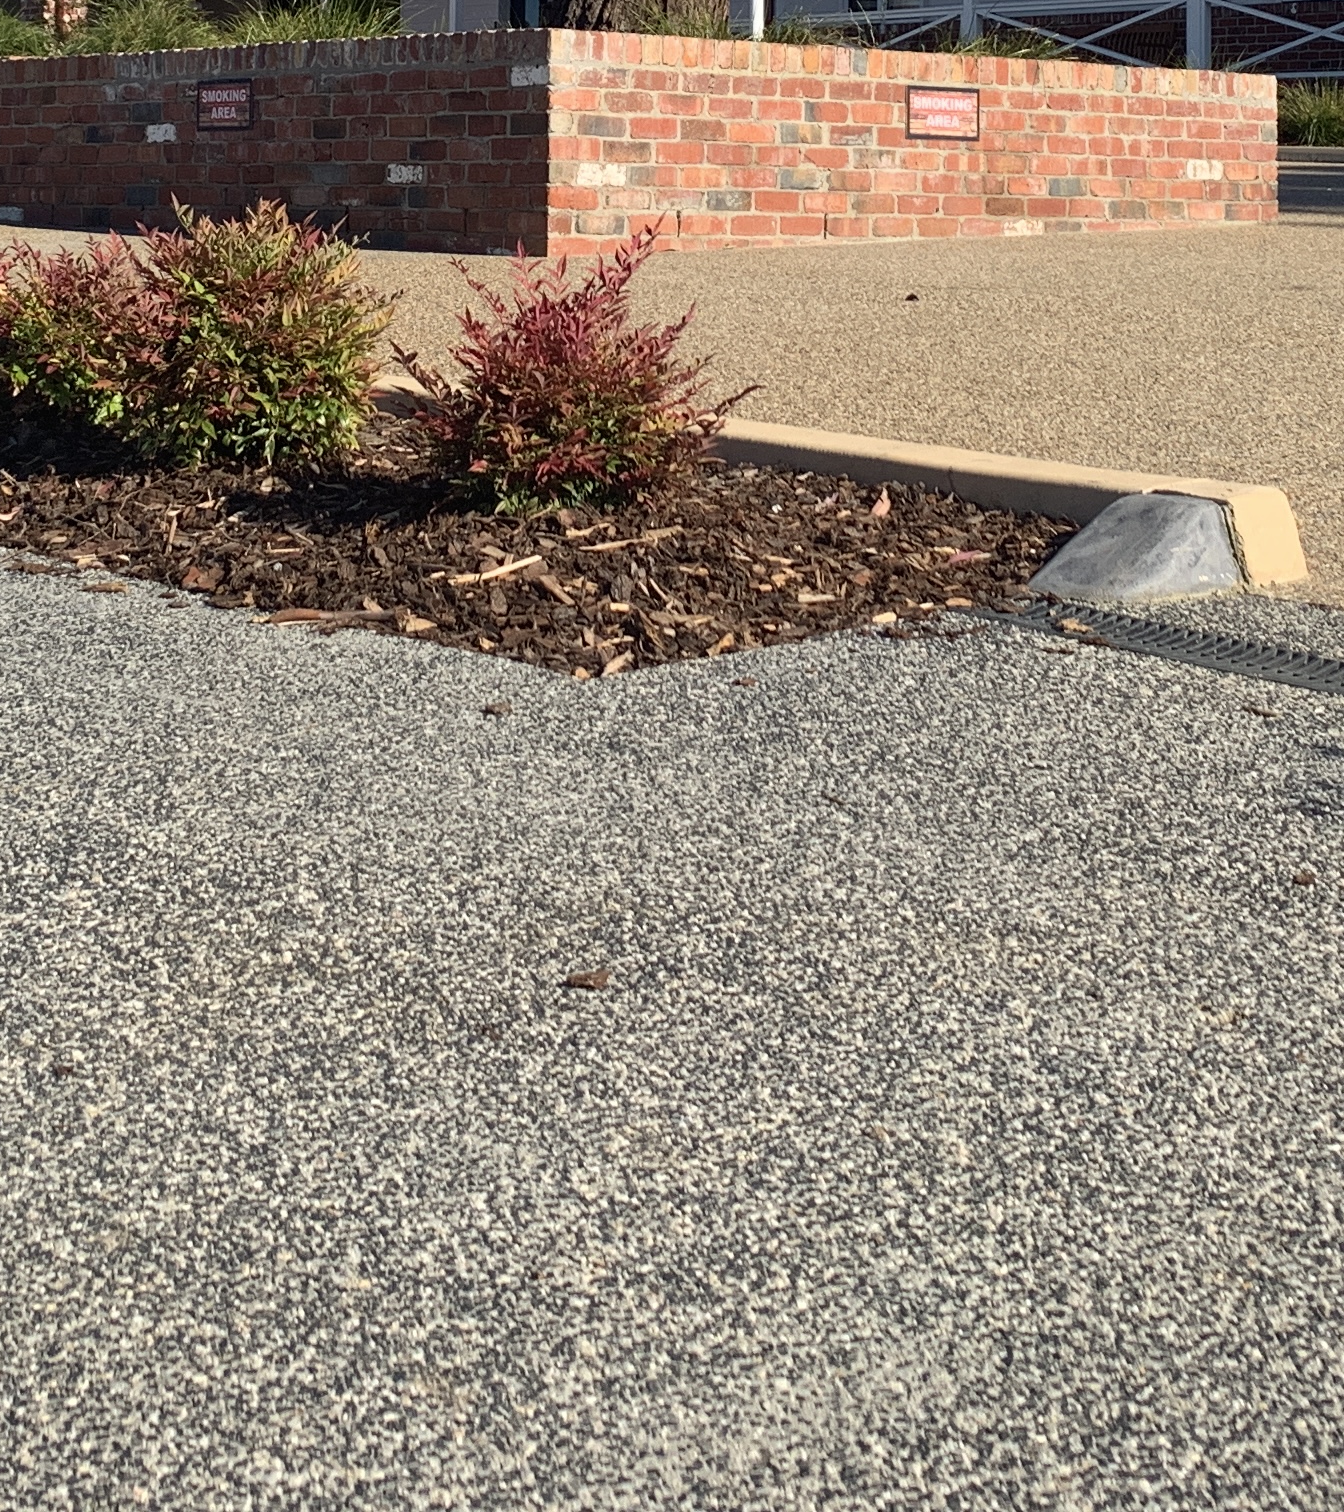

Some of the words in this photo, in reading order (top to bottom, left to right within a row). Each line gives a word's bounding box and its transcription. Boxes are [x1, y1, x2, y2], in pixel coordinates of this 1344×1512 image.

[201, 89, 247, 103] SMOKING
[913, 96, 973, 111] SMOKING
[210, 106, 237, 119] AREA
[925, 114, 960, 128] AREA
